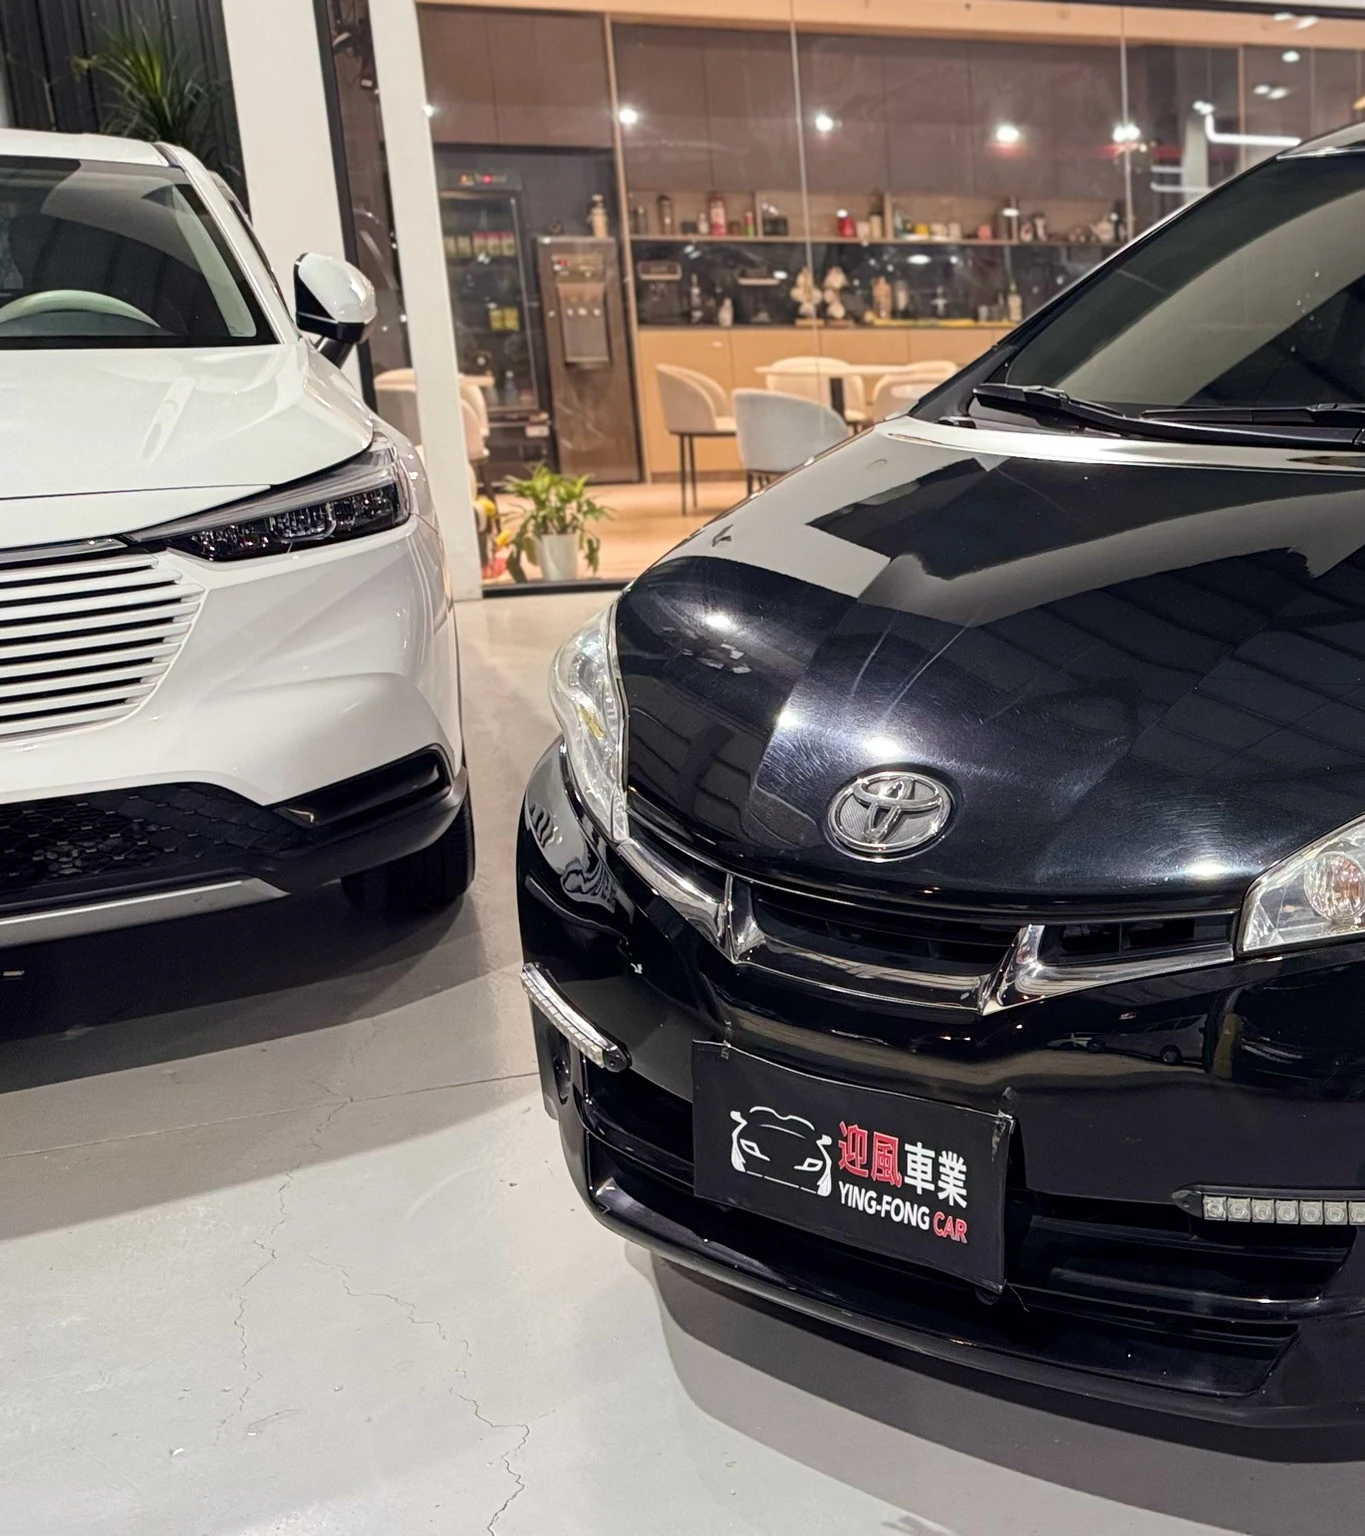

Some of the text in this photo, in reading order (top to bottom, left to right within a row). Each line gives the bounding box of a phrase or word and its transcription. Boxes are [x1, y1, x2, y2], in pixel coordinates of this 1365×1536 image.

[838, 1120, 967, 1208] 迎風車業
[838, 1181, 968, 1243] YING-FONG CAR
